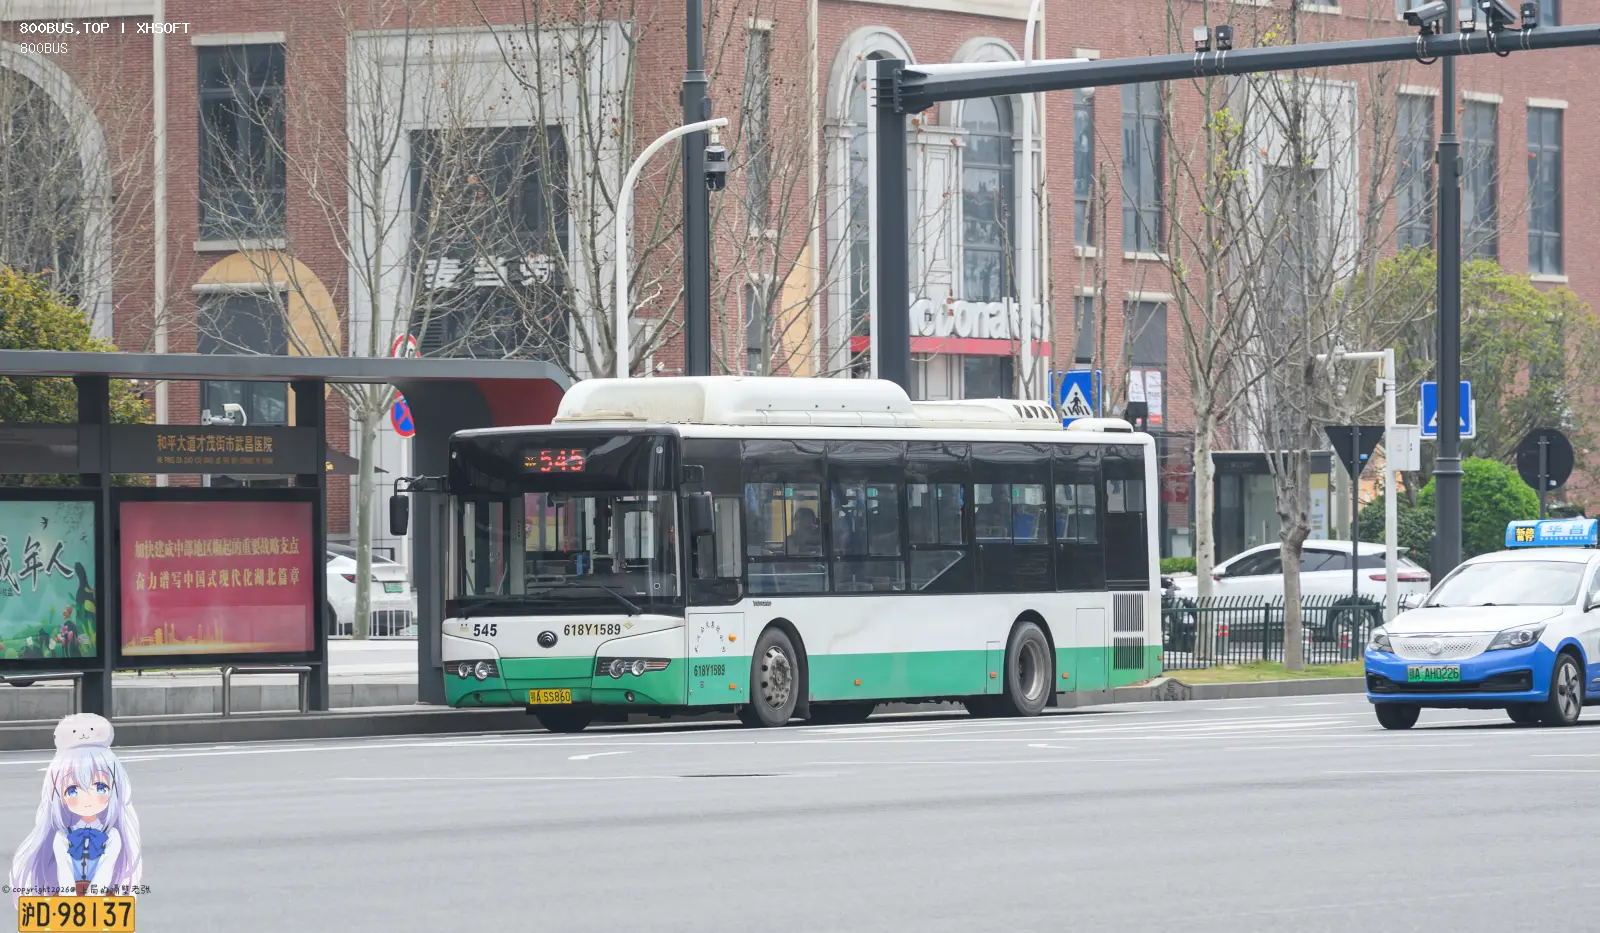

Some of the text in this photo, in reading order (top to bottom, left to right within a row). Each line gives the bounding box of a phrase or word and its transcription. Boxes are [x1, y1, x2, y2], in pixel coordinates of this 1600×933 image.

[157, 434, 273, 453] 和平大道才茂街市武昌医院
[540, 449, 584, 472] 545
[136, 567, 300, 590] 奋力谱写中国式现代化湖北篇章
[473, 623, 497, 637] 545
[563, 623, 621, 636] 618Y1589
[694, 664, 726, 677] 618Y1589
